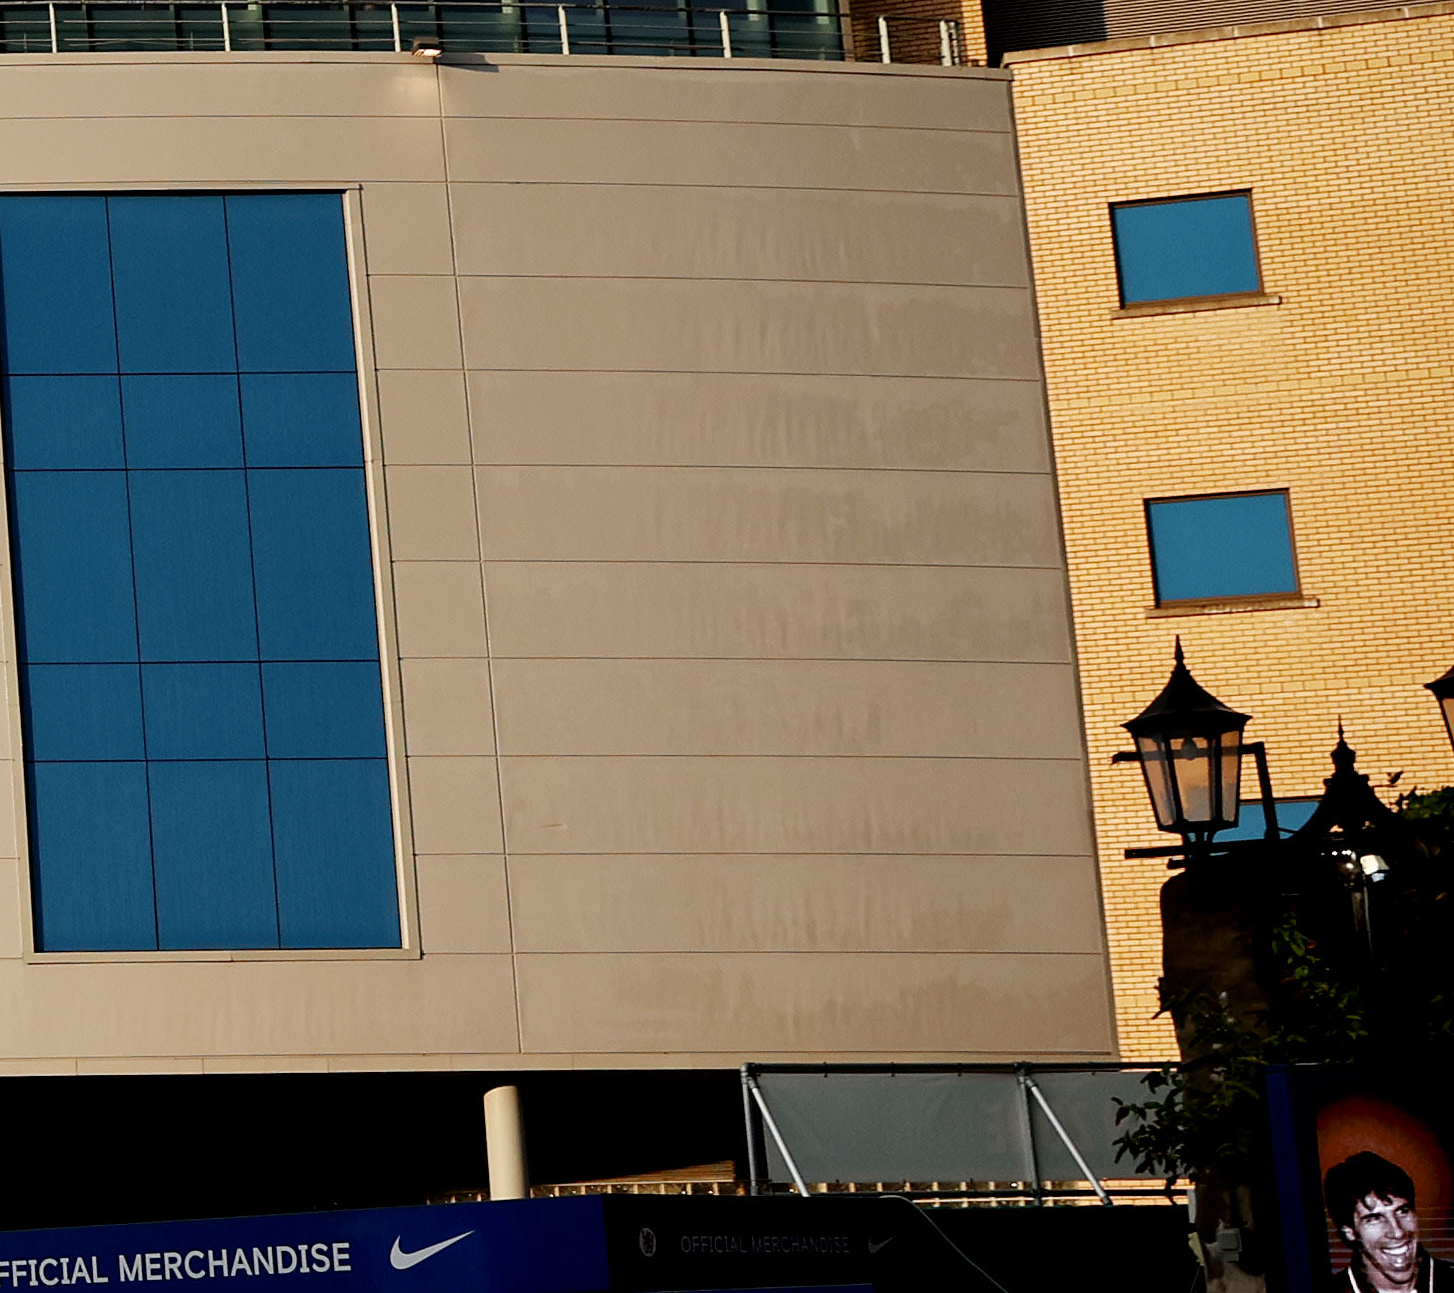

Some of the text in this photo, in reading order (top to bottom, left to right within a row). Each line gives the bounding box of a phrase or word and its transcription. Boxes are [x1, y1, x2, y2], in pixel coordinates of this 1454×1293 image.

[680, 1235, 851, 1254] OFFICIAL MERCHANDISE
[118, 1242, 352, 1283] MERCHANDISE
